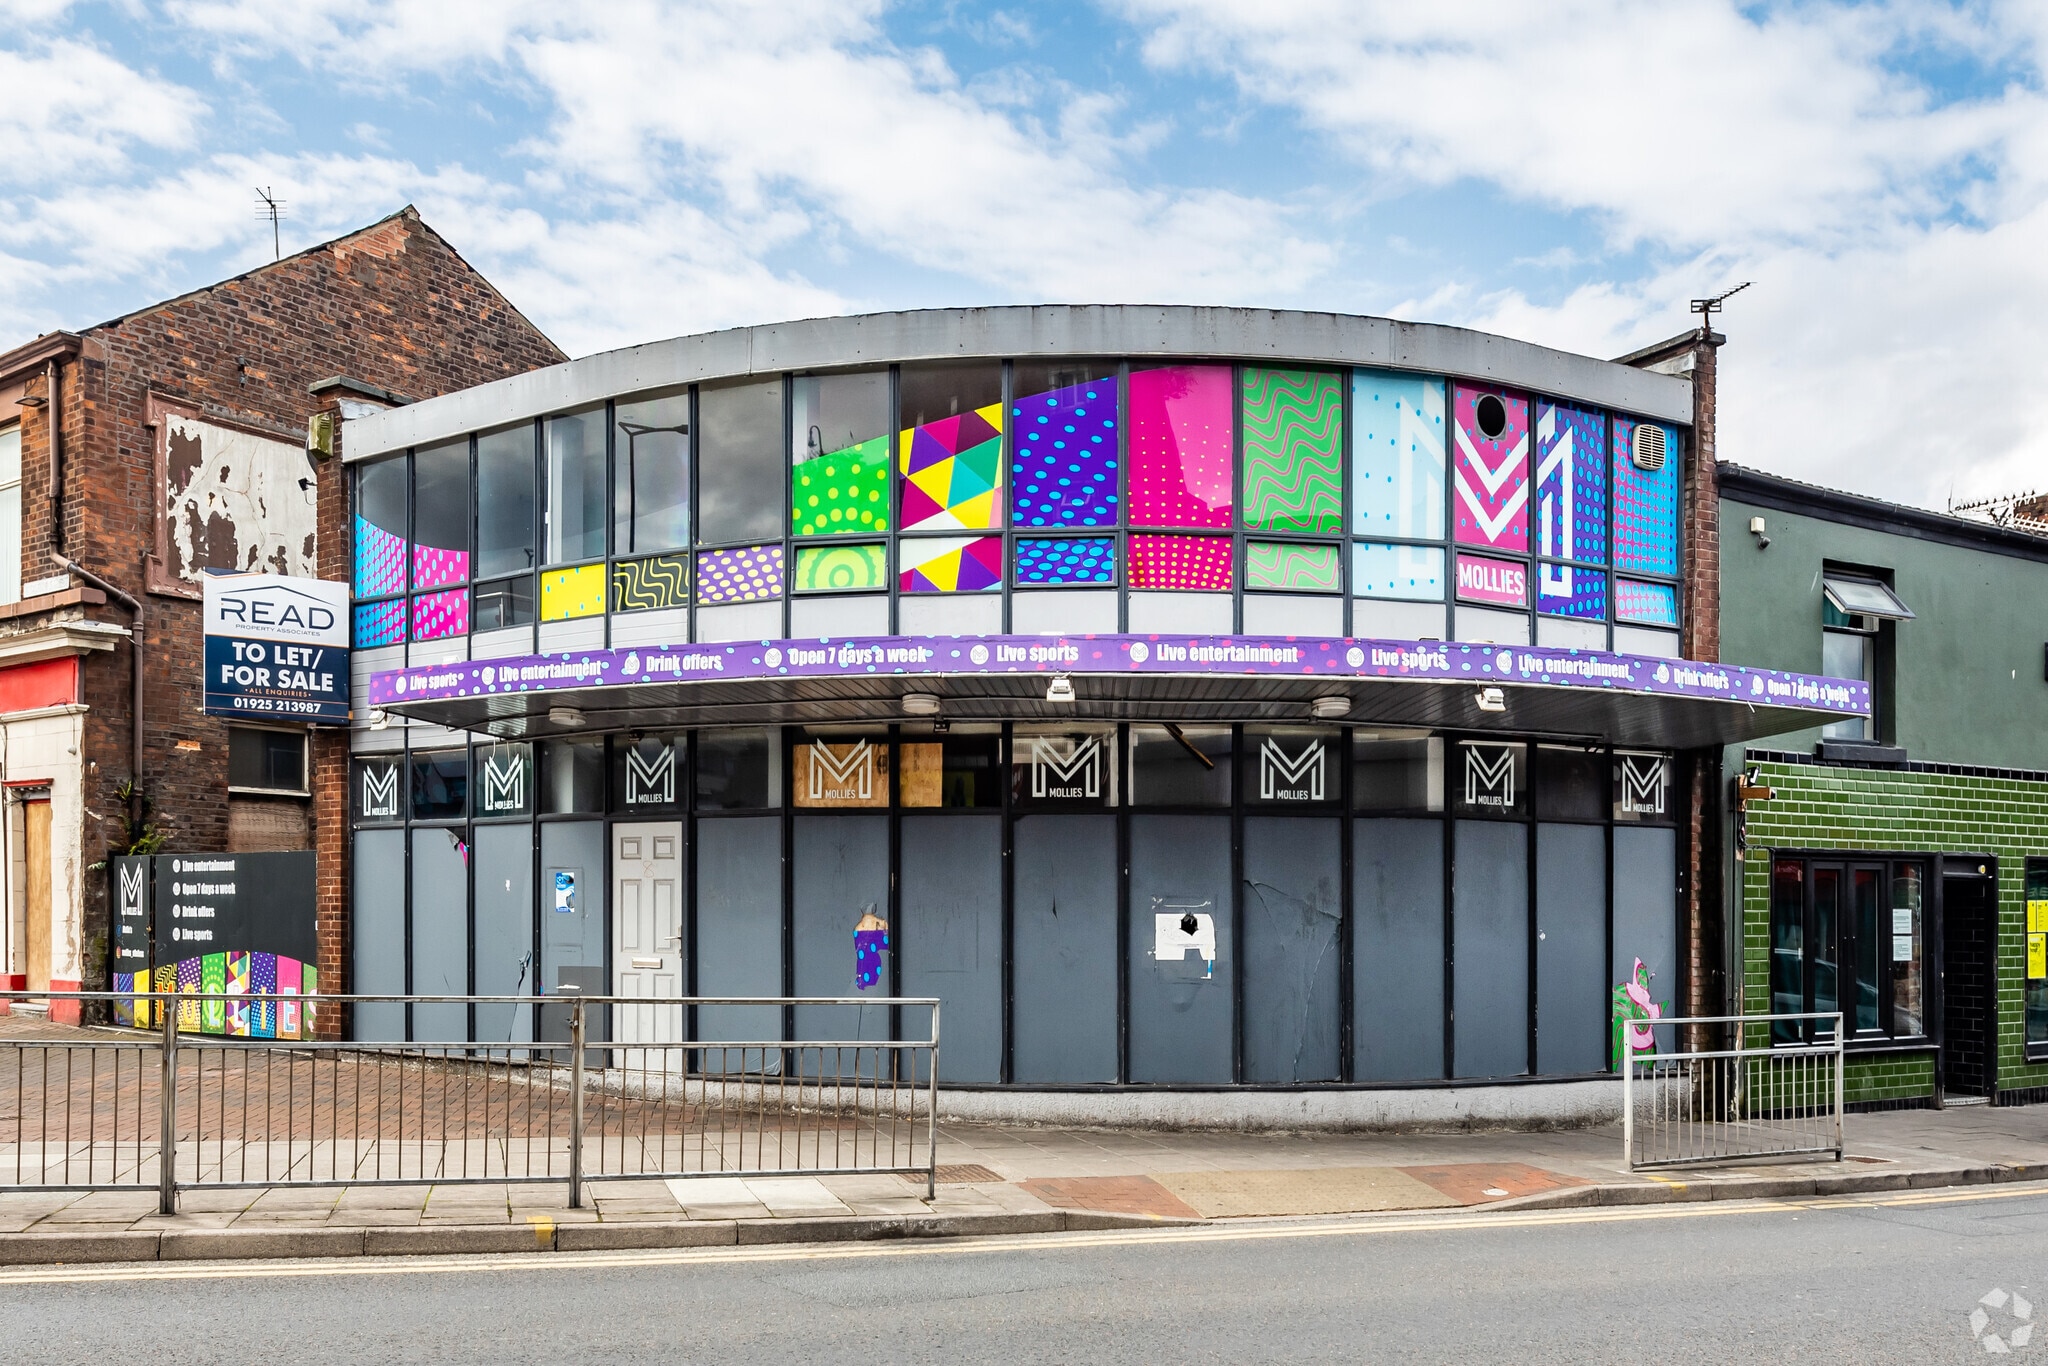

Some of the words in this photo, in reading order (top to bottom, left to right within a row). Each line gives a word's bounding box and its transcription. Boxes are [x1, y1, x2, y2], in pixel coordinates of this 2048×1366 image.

[1458, 562, 1524, 596] MOLLIES
[221, 598, 334, 630] READ
[235, 624, 275, 632] PROPERTY
[277, 628, 320, 637] ASSOCIATES
[232, 642, 266, 662] TO
[274, 645, 323, 669] LET/
[789, 648, 828, 666] Open
[828, 648, 838, 664] 7
[838, 646, 873, 666] days
[874, 649, 885, 663] a
[886, 646, 927, 663] week
[996, 645, 1026, 662] Live
[1029, 645, 1079, 663] sports
[1157, 644, 1187, 661] Live
[1189, 644, 1298, 663] entertainment
[1371, 648, 1399, 667] Live
[1401, 651, 1447, 668] sports
[499, 666, 520, 682] Live
[520, 660, 602, 681] entertainment
[645, 655, 681, 672] Drink
[682, 653, 722, 670] offers
[1518, 655, 1544, 674] Live
[1545, 657, 1631, 679] entertainment
[221, 664, 271, 687] FOR
[277, 669, 333, 692] SALE
[410, 674, 428, 691] Live
[428, 672, 458, 690] sports
[1673, 668, 1699, 687] Drink
[1700, 672, 1730, 690] offers
[265, 689, 308, 698] ENQUIRIES
[1767, 679, 1791, 698] Open
[1791, 681, 1797, 697] 7
[1797, 681, 1819, 701] days
[1820, 686, 1827, 700] a
[1827, 687, 1850, 703] week
[233, 697, 273, 710] 01925
[276, 700, 322, 713] 213987
[638, 793, 663, 804] MOLLIES
[825, 789, 856, 799] MOLLIES
[1049, 787, 1083, 798] MOLLIES
[1277, 789, 1309, 800] MOLLIES
[1477, 795, 1502, 806] MOLLIES
[371, 806, 389, 816] MOLLIES
[494, 799, 514, 810] MOLLIES
[1632, 803, 1655, 814] MOLLIES
[182, 860, 194, 872] Live
[194, 859, 236, 872] entertainment
[643, 860, 655, 879] 8
[182, 882, 197, 896] Open
[201, 882, 215, 896] days
[219, 882, 236, 895] week
[182, 905, 198, 918] Drink
[198, 905, 215, 918] offers
[182, 928, 194, 940] Live
[194, 929, 213, 941] sports
